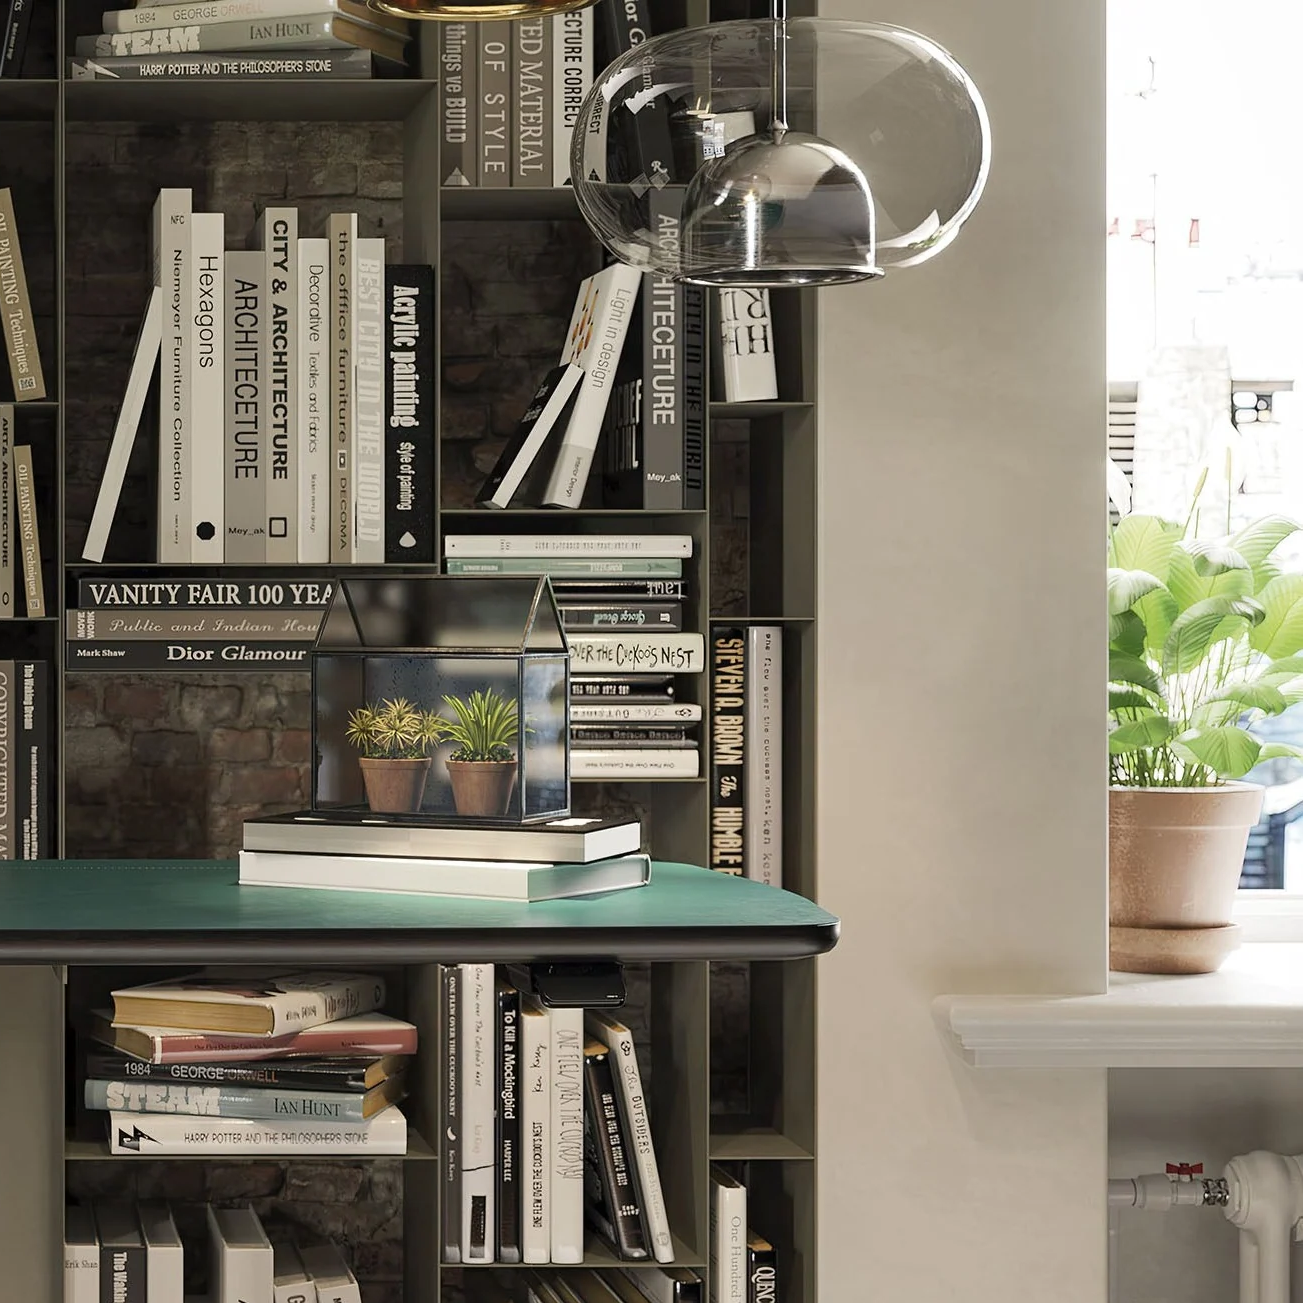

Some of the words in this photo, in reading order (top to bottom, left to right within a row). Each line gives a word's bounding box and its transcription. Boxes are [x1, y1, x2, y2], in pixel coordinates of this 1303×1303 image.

[273, 220, 288, 272] CITY
[272, 277, 288, 294] &
[610, 288, 631, 326] Light
[195, 256, 218, 368] Hexagons
[390, 285, 420, 347] Acrylic
[605, 328, 621, 342] in
[9, 309, 29, 374] Techniques
[234, 279, 258, 479] ARCHITECETURE
[592, 342, 613, 388] design
[272, 303, 288, 480] ARCHITECTURE
[390, 351, 420, 428] painting
[401, 464, 414, 476] of
[397, 478, 414, 511] painting
[90, 584, 181, 604] VANITY
[188, 584, 241, 604] FAIR
[249, 584, 283, 604] 100
[289, 584, 332, 604] YEA
[715, 638, 744, 693] STEVEN
[714, 715, 743, 765] BROWN
[504, 1010, 515, 1024] To
[505, 1028, 515, 1041] Kill
[125, 1062, 150, 1075] 1984
[171, 1066, 224, 1080] GEORGE
[501, 1054, 515, 1120] Mockingbird
[107, 1082, 220, 1115] STEAM
[275, 1099, 298, 1115] IAN
[302, 1100, 340, 1116] HUNT
[732, 1217, 741, 1243] One
[732, 1249, 741, 1295] Hundred
